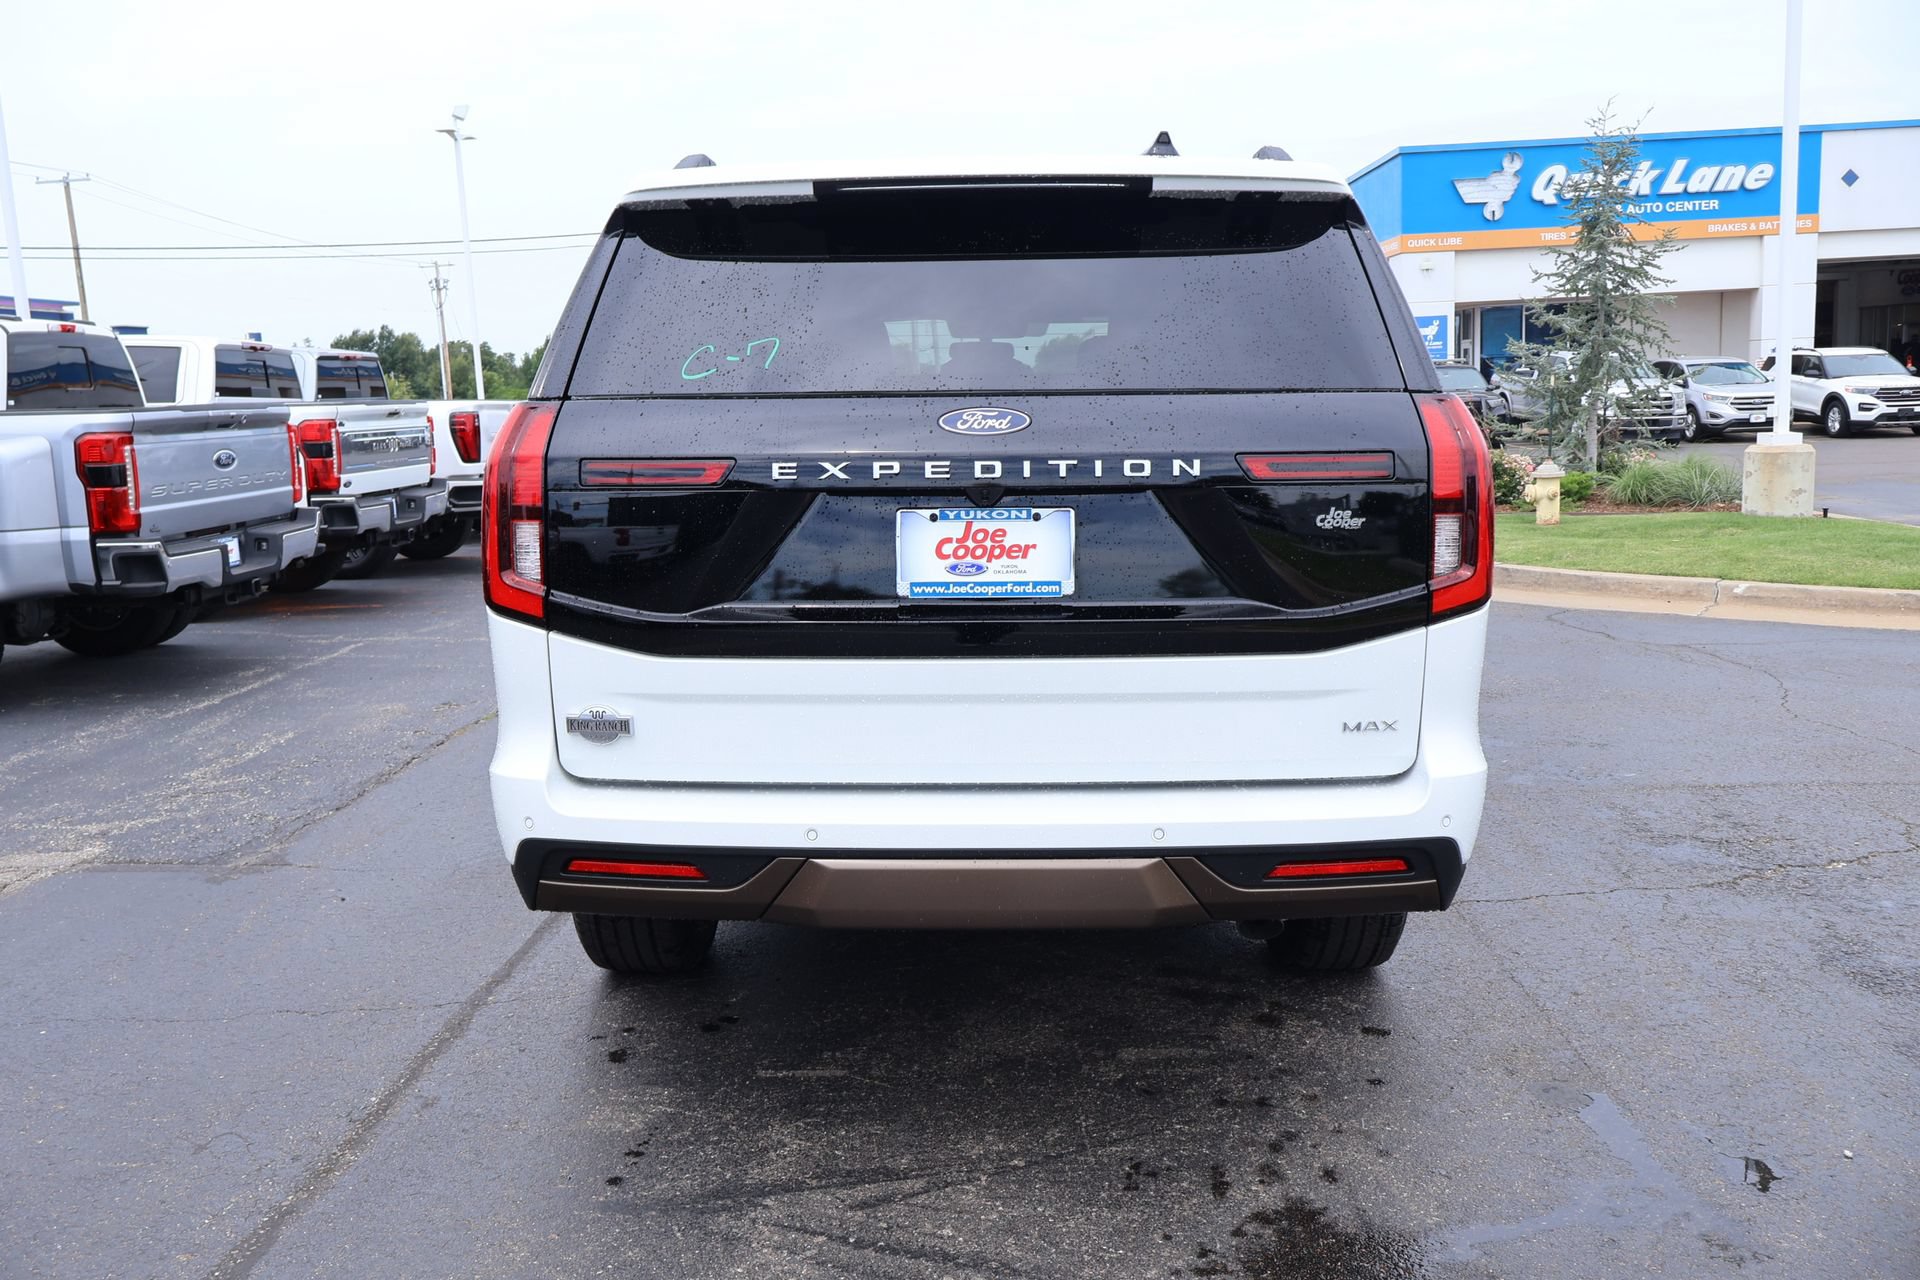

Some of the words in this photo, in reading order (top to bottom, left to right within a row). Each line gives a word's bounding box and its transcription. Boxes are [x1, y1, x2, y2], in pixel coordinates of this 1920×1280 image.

[1657, 158, 1775, 195] Lane
[1626, 202, 1663, 214] AUTO
[1667, 199, 1719, 213] CENTER
[1707, 222, 1747, 233] BRAKES
[1749, 221, 1757, 231] &
[1759, 219, 1812, 231] BATIES
[1407, 238, 1436, 248] QUICK
[1438, 237, 1463, 246] LUBE
[1540, 232, 1567, 241] TIRES
[771, 459, 1202, 480] EXPEDITION
[151, 477, 233, 498] SUPER
[239, 470, 288, 488] DUTY
[943, 509, 1028, 520] YUKON
[1326, 506, 1352, 519] Joe
[1315, 514, 1366, 529] Cooper
[955, 520, 1008, 545] Joe
[935, 537, 1038, 563] Cooper
[912, 583, 1060, 596] www.JoeCooperFord.com
[570, 719, 593, 731] KING
[595, 719, 627, 732] RANCH
[1342, 720, 1399, 732] MAX
